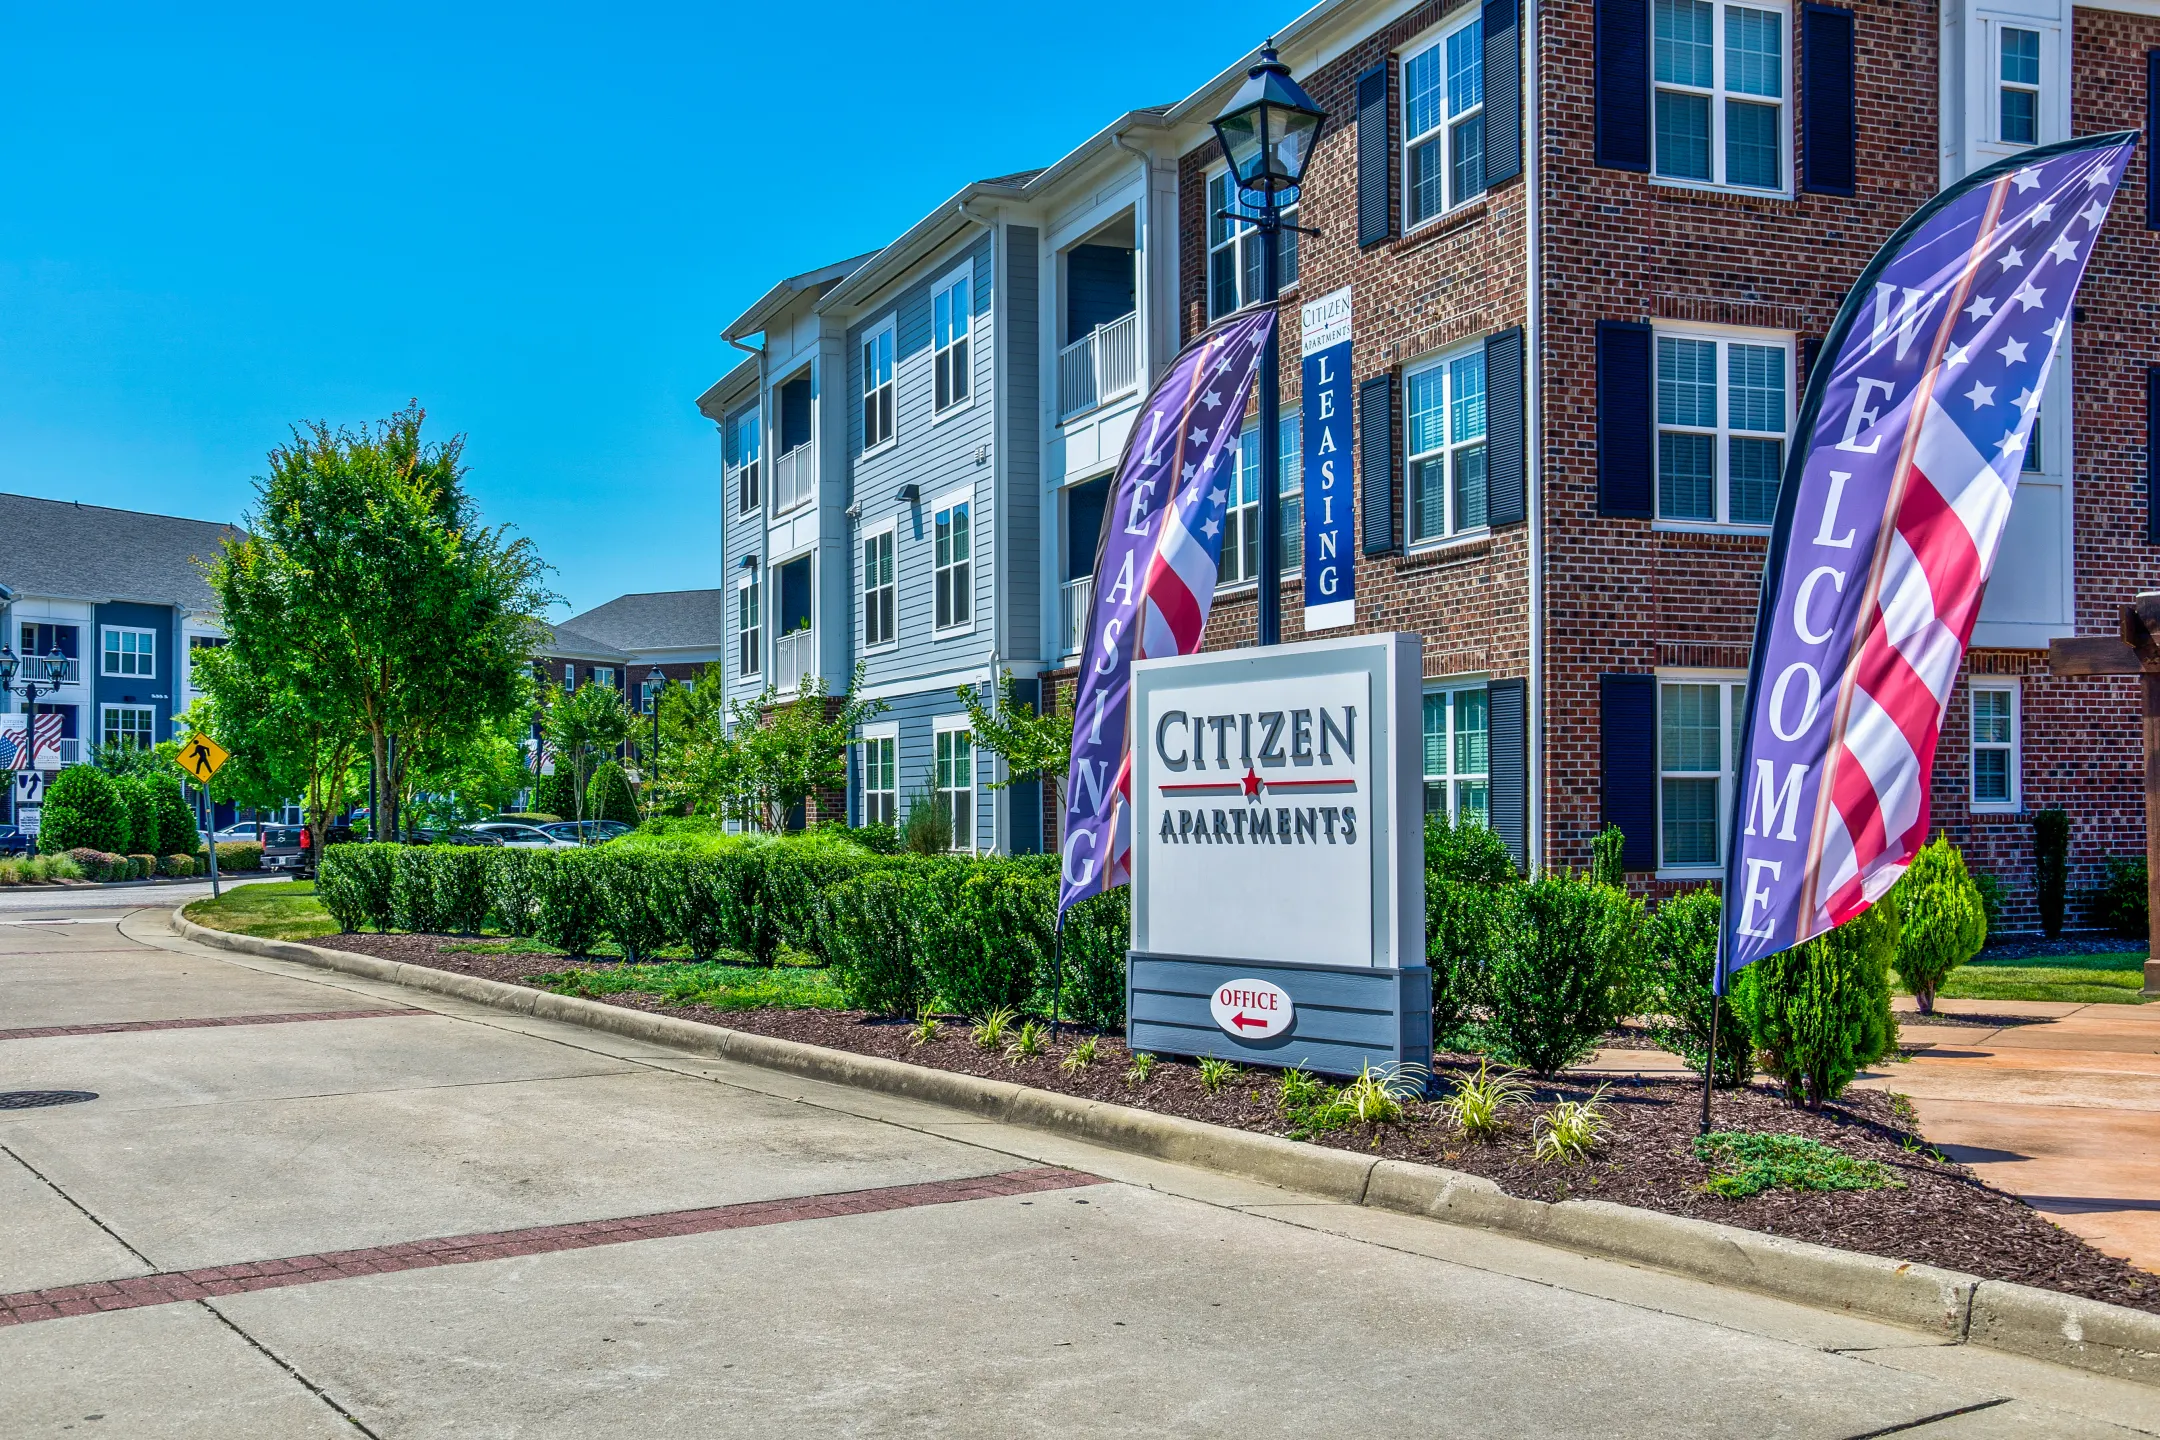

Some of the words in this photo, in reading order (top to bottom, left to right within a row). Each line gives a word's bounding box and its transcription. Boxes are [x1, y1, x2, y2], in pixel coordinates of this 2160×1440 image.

[1302, 290, 1350, 328] CITIZEN
[1304, 324, 1350, 351] APARTMENTS
[1318, 355, 1339, 596] LEASING
[1735, 282, 1944, 940] WELCOME
[1062, 410, 1165, 888] LEASING
[1155, 705, 1356, 766] CITIZEN
[1159, 806, 1356, 839] APARTMENTS
[1220, 988, 1278, 1011] OFFICE
